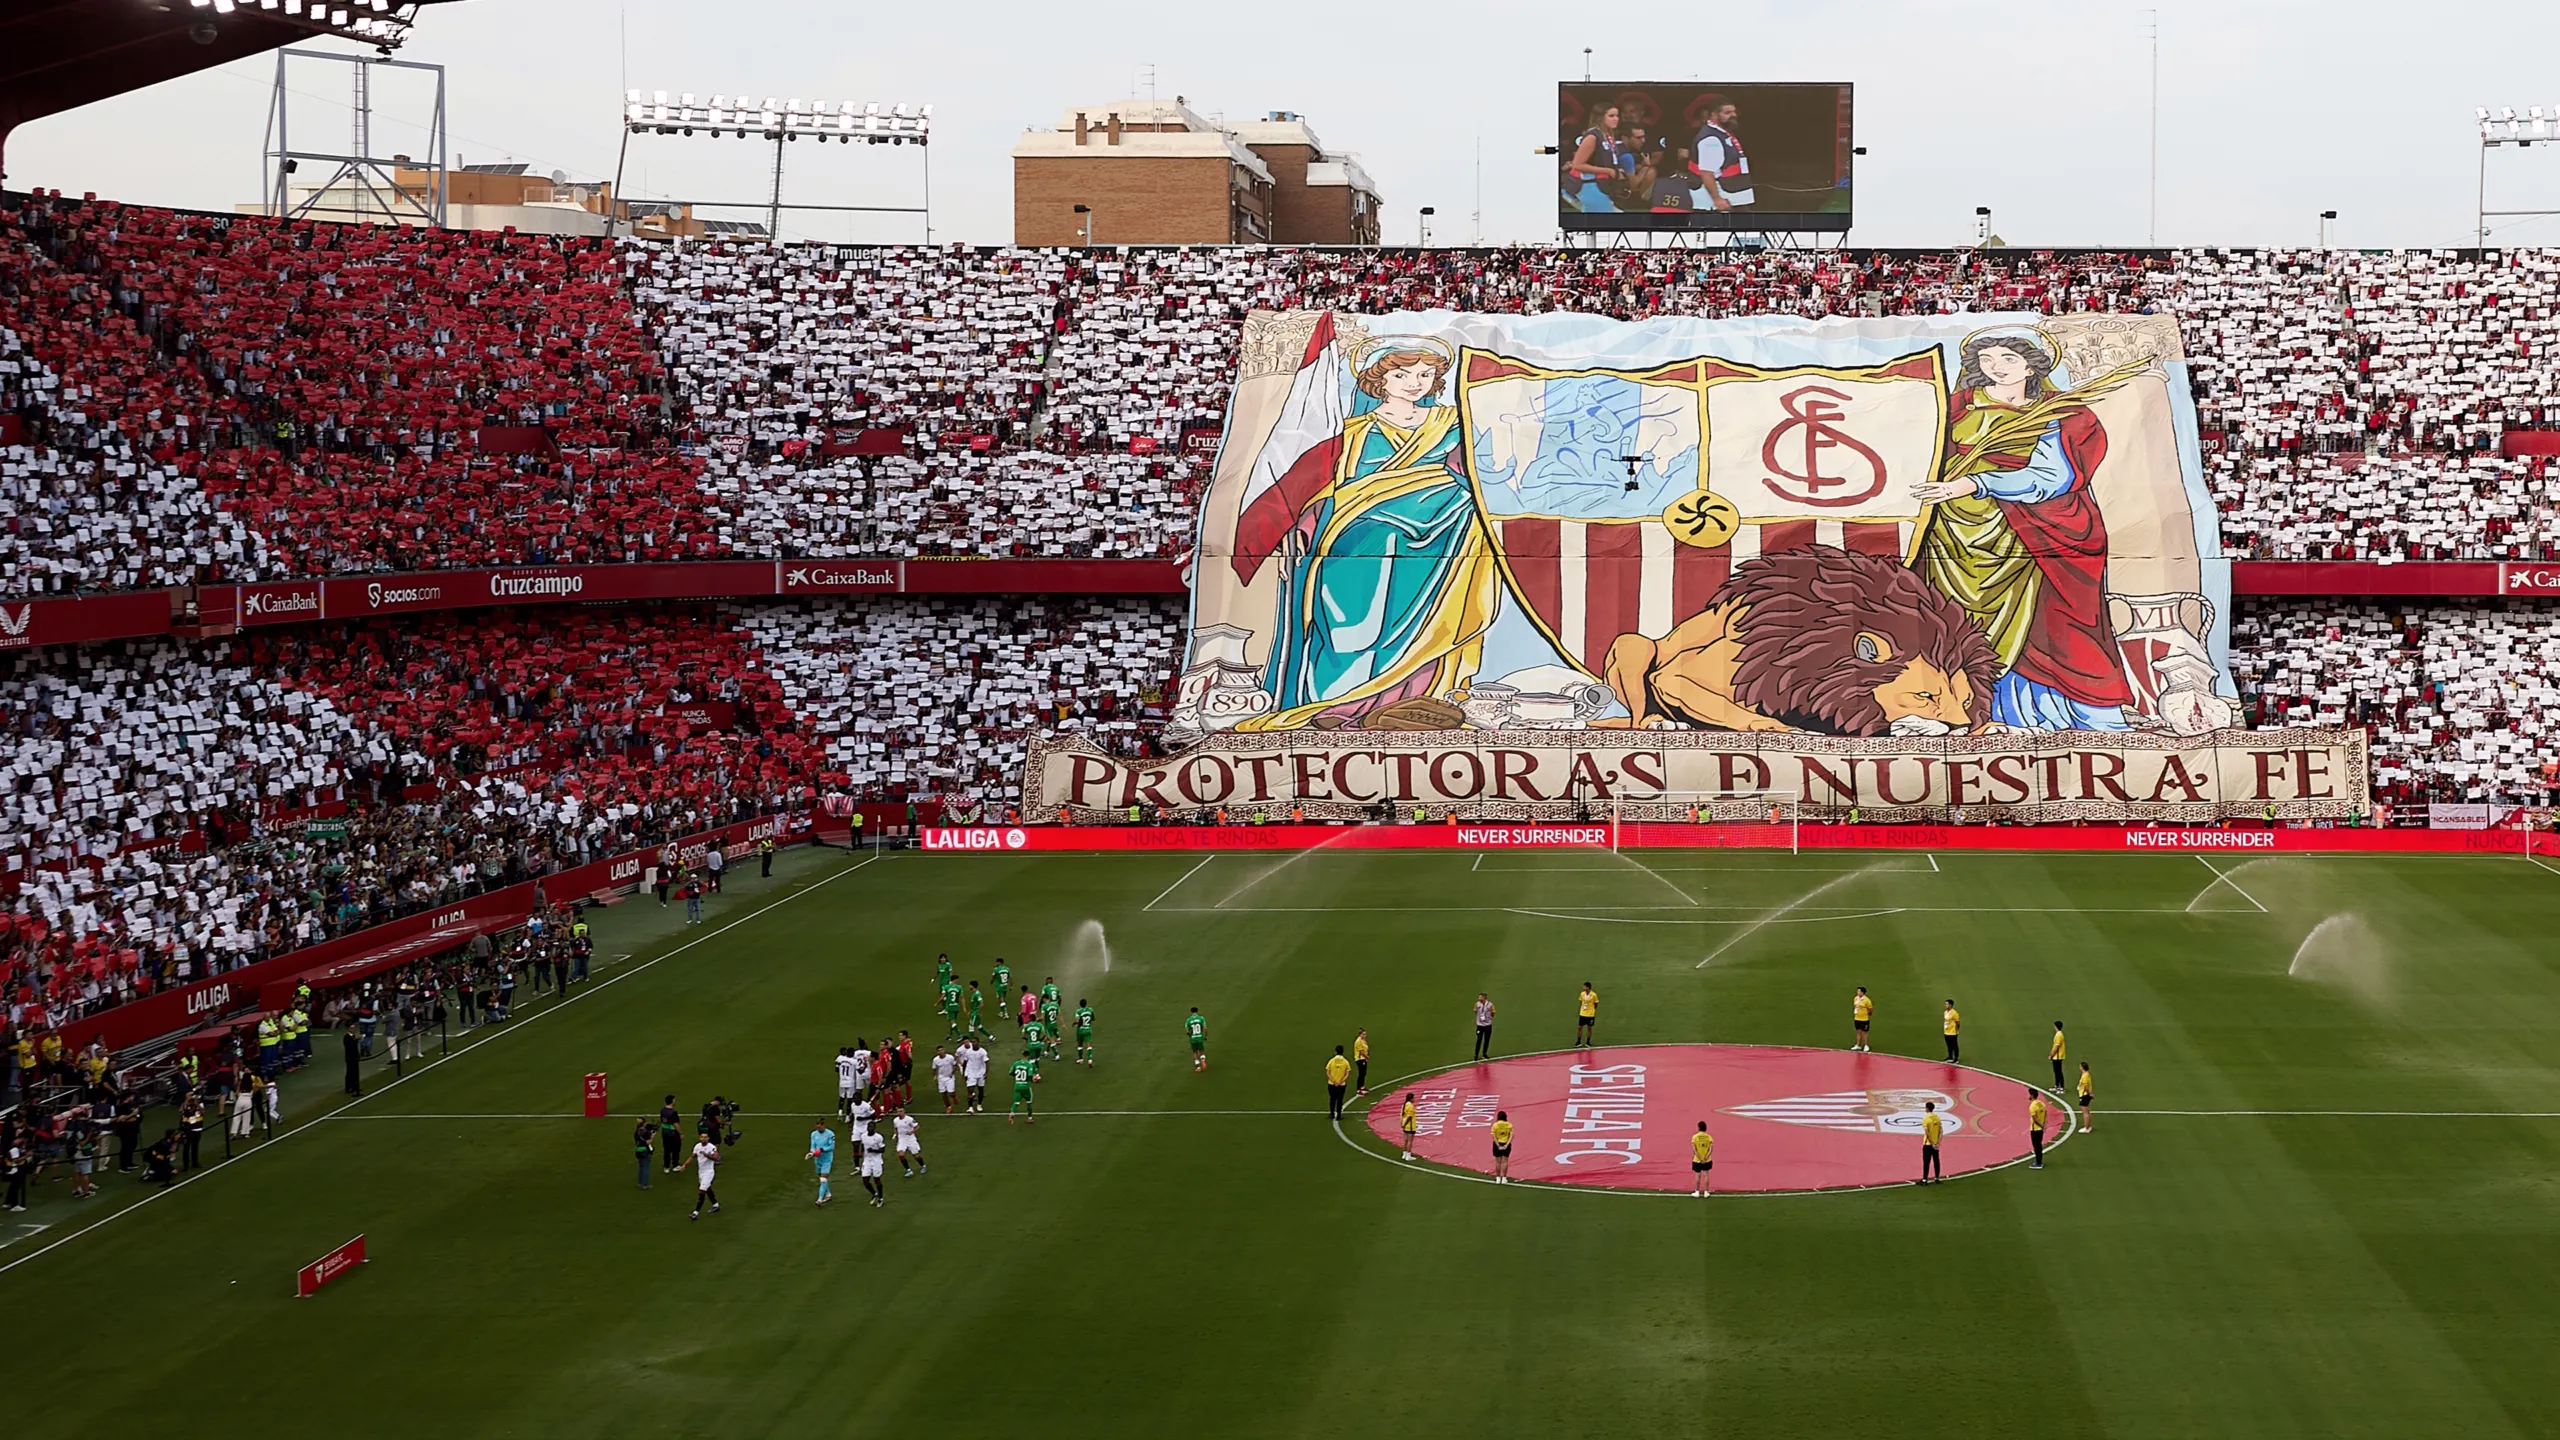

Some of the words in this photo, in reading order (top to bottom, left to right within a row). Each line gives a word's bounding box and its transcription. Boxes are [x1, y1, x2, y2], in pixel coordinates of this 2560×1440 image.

[1662, 195, 1680, 207] 35
[811, 568, 895, 585] CaixaBank
[490, 573, 583, 597] Cruzcampo
[262, 592, 318, 613] CaixaBank
[2133, 605, 2177, 628] VII
[1202, 693, 1267, 713] 1890
[1068, 750, 1668, 808] PROTECTORAS
[1794, 750, 2210, 807] NUESTRA
[2247, 747, 2334, 800] FE
[748, 821, 774, 842] LALIGA
[925, 829, 1001, 848] LALIGA
[1126, 830, 1185, 846] NUNCA
[1191, 830, 1210, 846] TE
[1217, 830, 1278, 846] RINDAS
[1457, 828, 1509, 844] NEVER
[1512, 828, 1606, 844] SURRENDER
[1860, 829, 1882, 844] TE
[1887, 829, 1948, 845] RINDAS
[2126, 831, 2178, 846] NEVER
[2181, 831, 2275, 847] SURRENDER
[2466, 833, 2525, 848] NUNCA
[610, 858, 640, 881] LALIGA
[1000, 973, 1008, 983] 18
[187, 982, 230, 1014] LALIGA
[950, 991, 956, 999] 3
[1081, 1015, 1091, 1026] 12
[1030, 1031, 1037, 1041] 8
[1191, 1023, 1201, 1035] 10
[842, 1065, 849, 1076] 11
[1014, 1069, 1027, 1081] 20
[1421, 1088, 1457, 1099] TE
[1562, 1064, 1647, 1133] SEVILLA
[1456, 1095, 1500, 1128] NUNCA
[1554, 1138, 1643, 1165] FC
